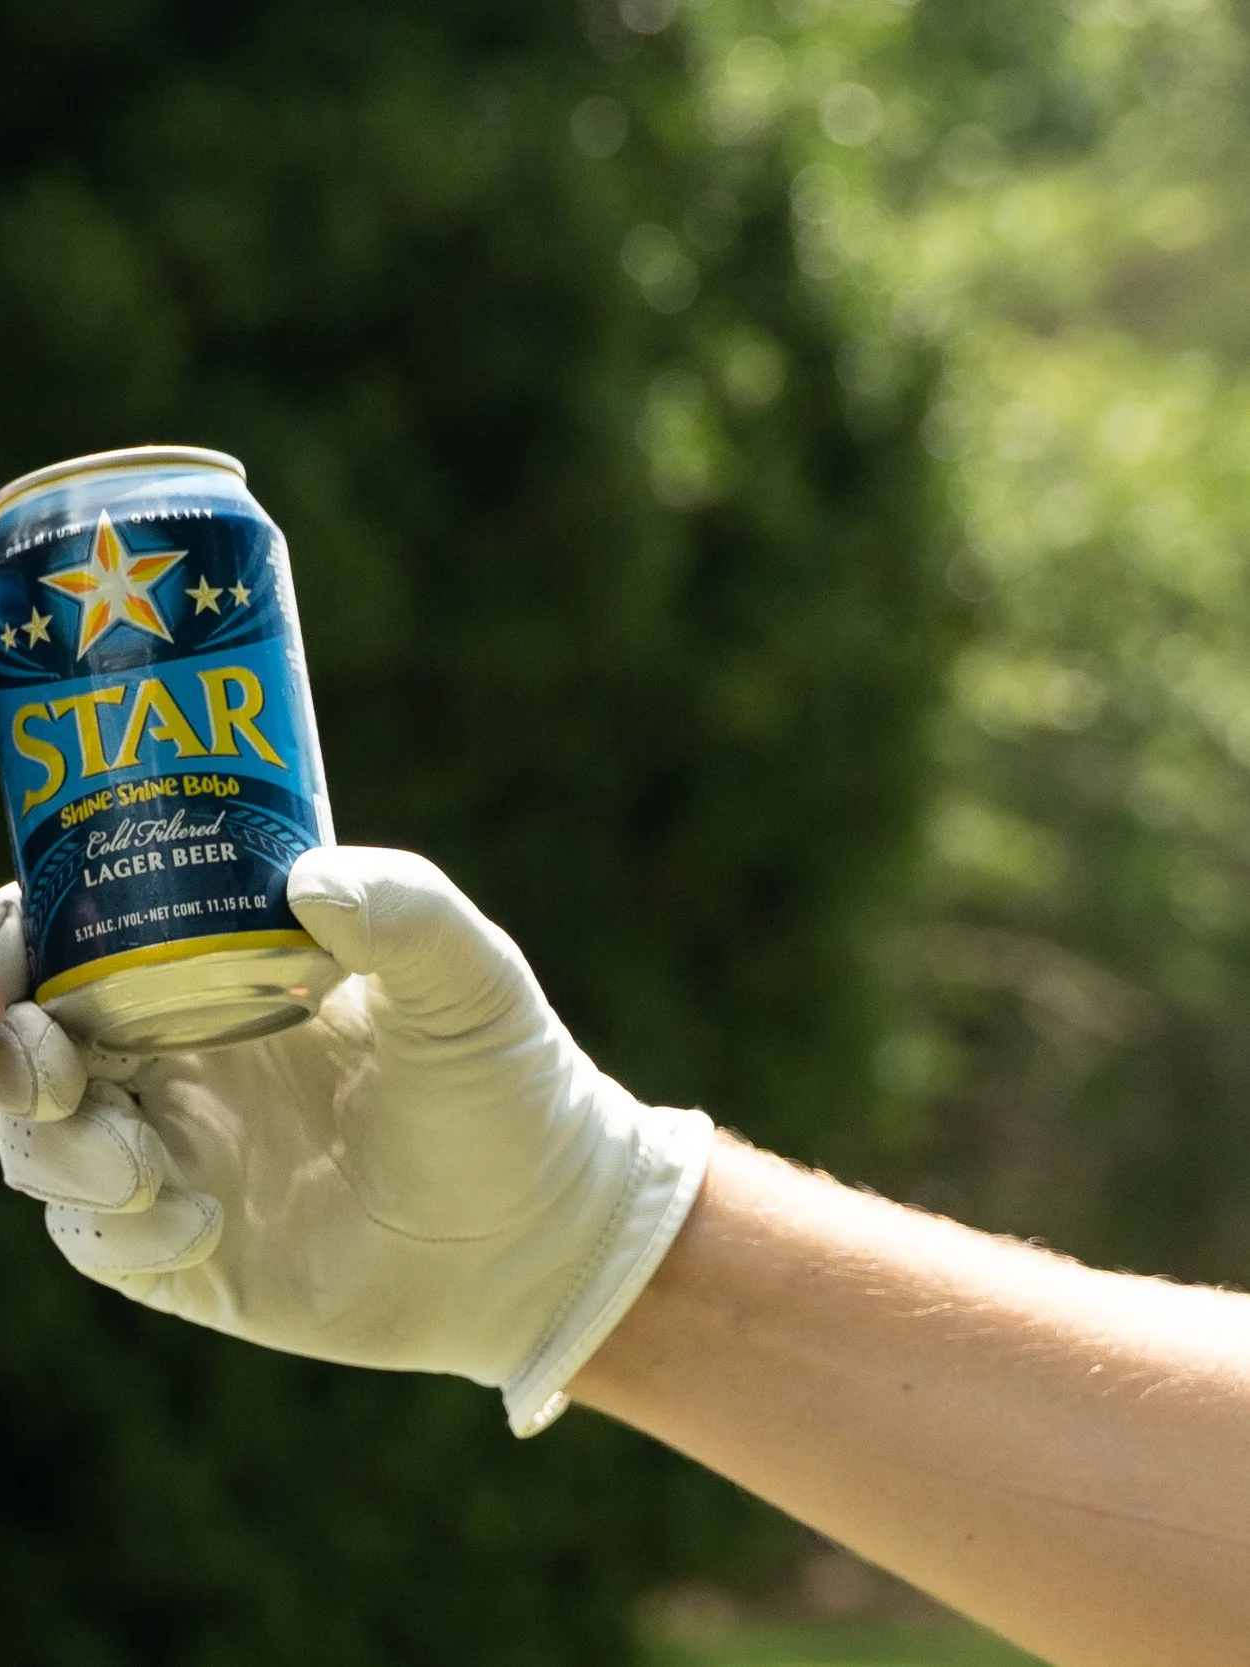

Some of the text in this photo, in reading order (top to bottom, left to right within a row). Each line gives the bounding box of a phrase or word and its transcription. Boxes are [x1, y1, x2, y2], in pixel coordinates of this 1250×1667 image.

[5, 508, 213, 558] PREMIUM QUALITY
[10, 665, 289, 818] STAR
[182, 774, 240, 798] Bobo
[85, 808, 227, 860] Cold Filtered
[83, 842, 238, 888] LAGER BEER
[74, 922, 96, 943] 5.1%
[172, 902, 205, 919] CONT.
[205, 897, 237, 914] 11.15
[238, 895, 252, 909] FL
[254, 894, 268, 909] OZ
